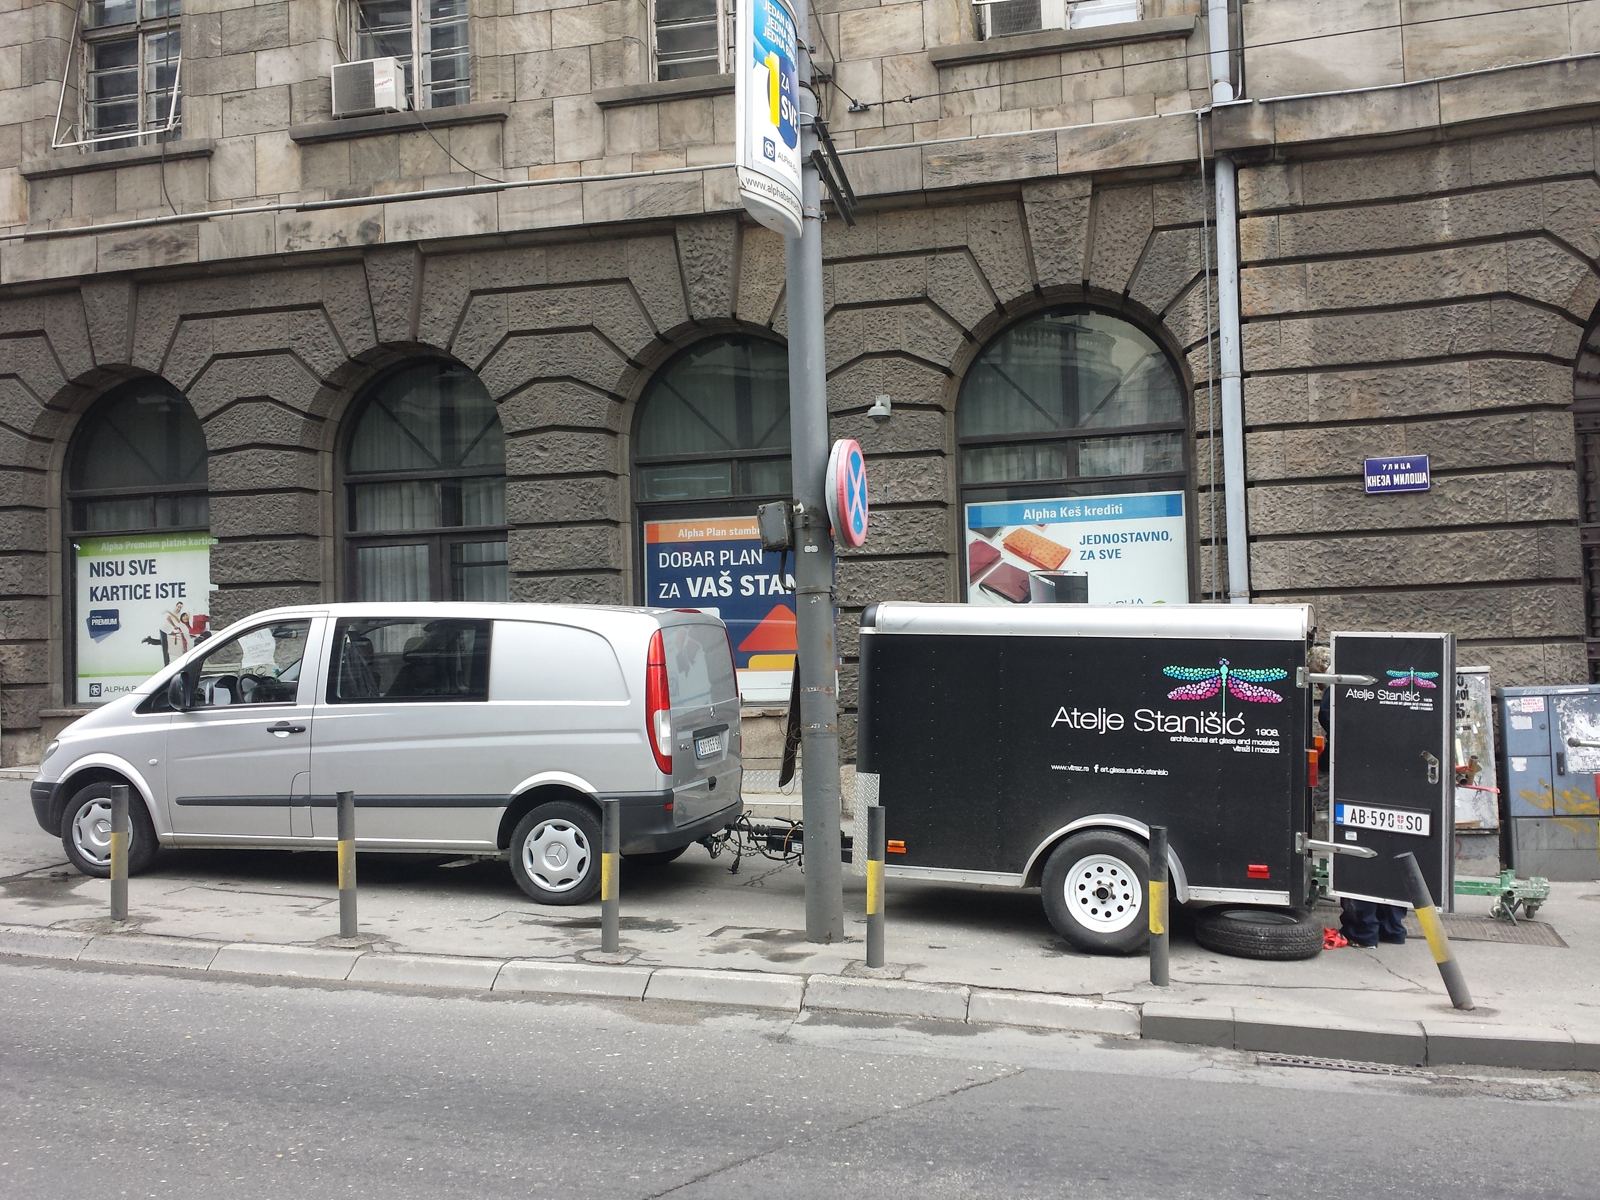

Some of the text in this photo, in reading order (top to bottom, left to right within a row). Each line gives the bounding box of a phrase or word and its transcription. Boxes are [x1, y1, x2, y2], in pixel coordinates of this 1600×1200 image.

[781, 72, 791, 94] ZA
[1382, 462, 1411, 471] УЛИЦА
[1367, 472, 1427, 487] КНЕЗА МИЛОША
[1023, 503, 1123, 520] Alpha Keš krediti
[678, 527, 703, 539] Alpha
[706, 526, 727, 537] Plan
[1079, 530, 1173, 546] JEDNOSTAVNO,
[658, 549, 763, 568] DOBAR PLAN
[1079, 548, 1122, 561] ZA SVE
[89, 558, 157, 578] NISU SVE
[89, 581, 187, 602] KARTICE ISTE
[658, 583, 681, 599] ZA
[686, 570, 733, 598] VAŠ
[103, 685, 130, 693] ALPHA
[1345, 688, 1375, 701] Atelje
[1050, 706, 1246, 736] Atelje Stanišić
[1405, 815, 1423, 832] SO
